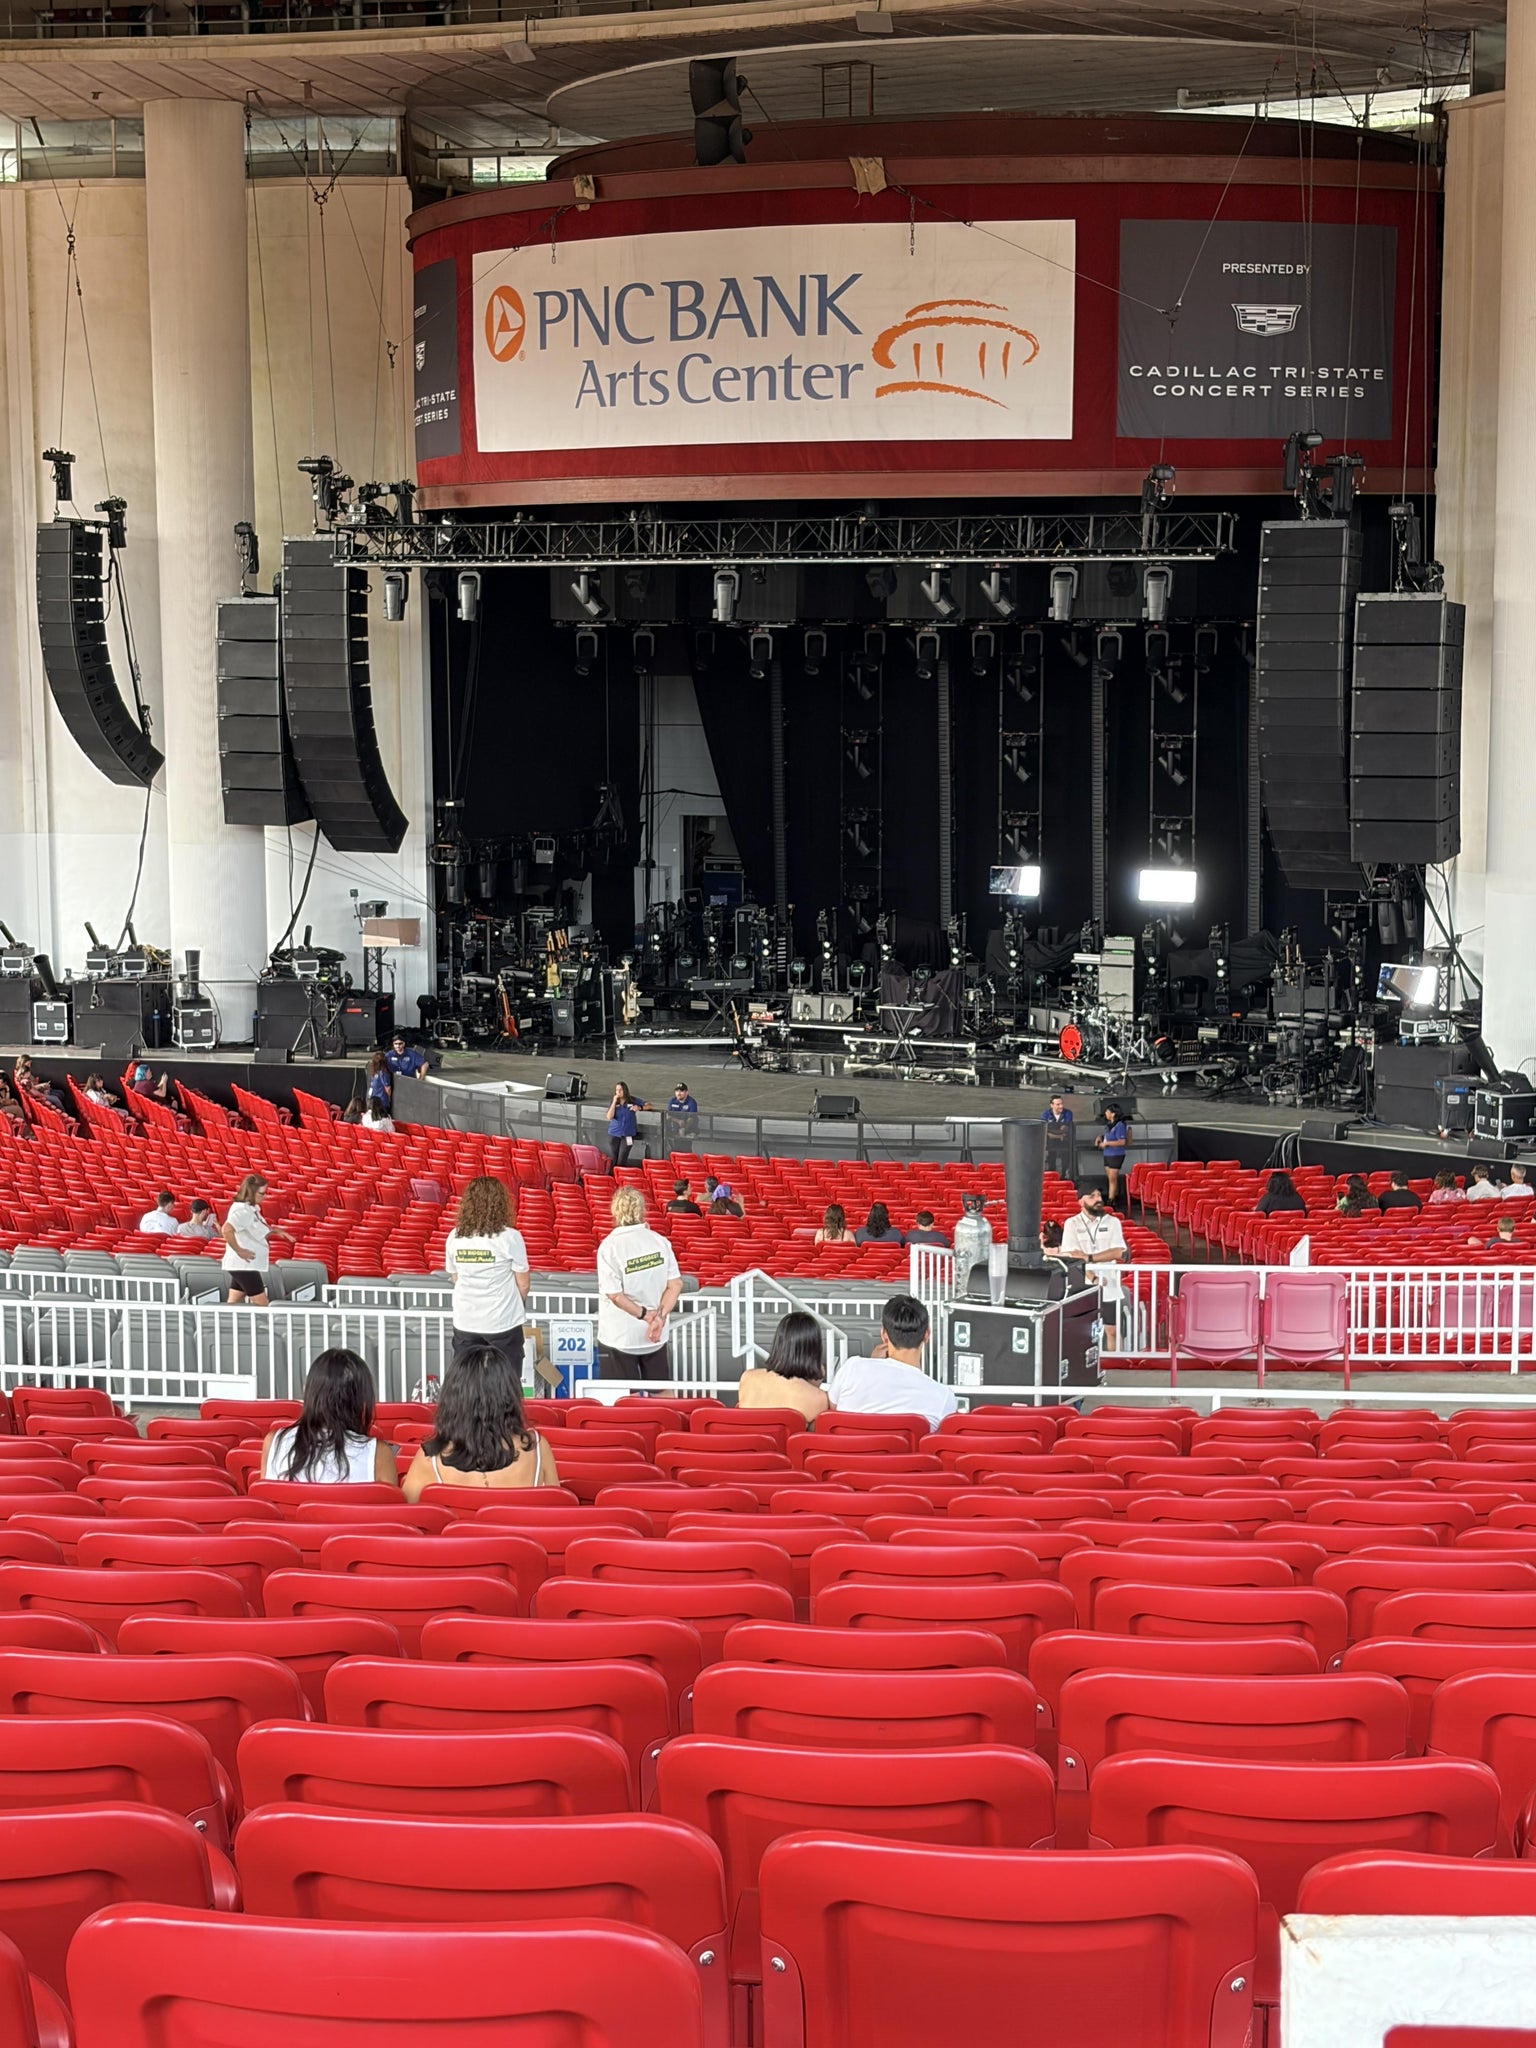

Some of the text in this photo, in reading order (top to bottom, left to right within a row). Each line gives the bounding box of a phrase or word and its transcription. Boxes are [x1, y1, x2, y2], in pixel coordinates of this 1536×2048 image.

[1222, 263, 1312, 275] PRESENTED BY
[532, 273, 863, 351] PNC BANK
[1129, 365, 1385, 380] CADILLAC TRI-STATE
[575, 353, 864, 409] Arts Center
[421, 390, 456, 406] TRI-STATE
[1153, 384, 1365, 398] CONCERT SERIES
[424, 408, 449, 423] SERIES
[557, 1337, 586, 1352] 202
